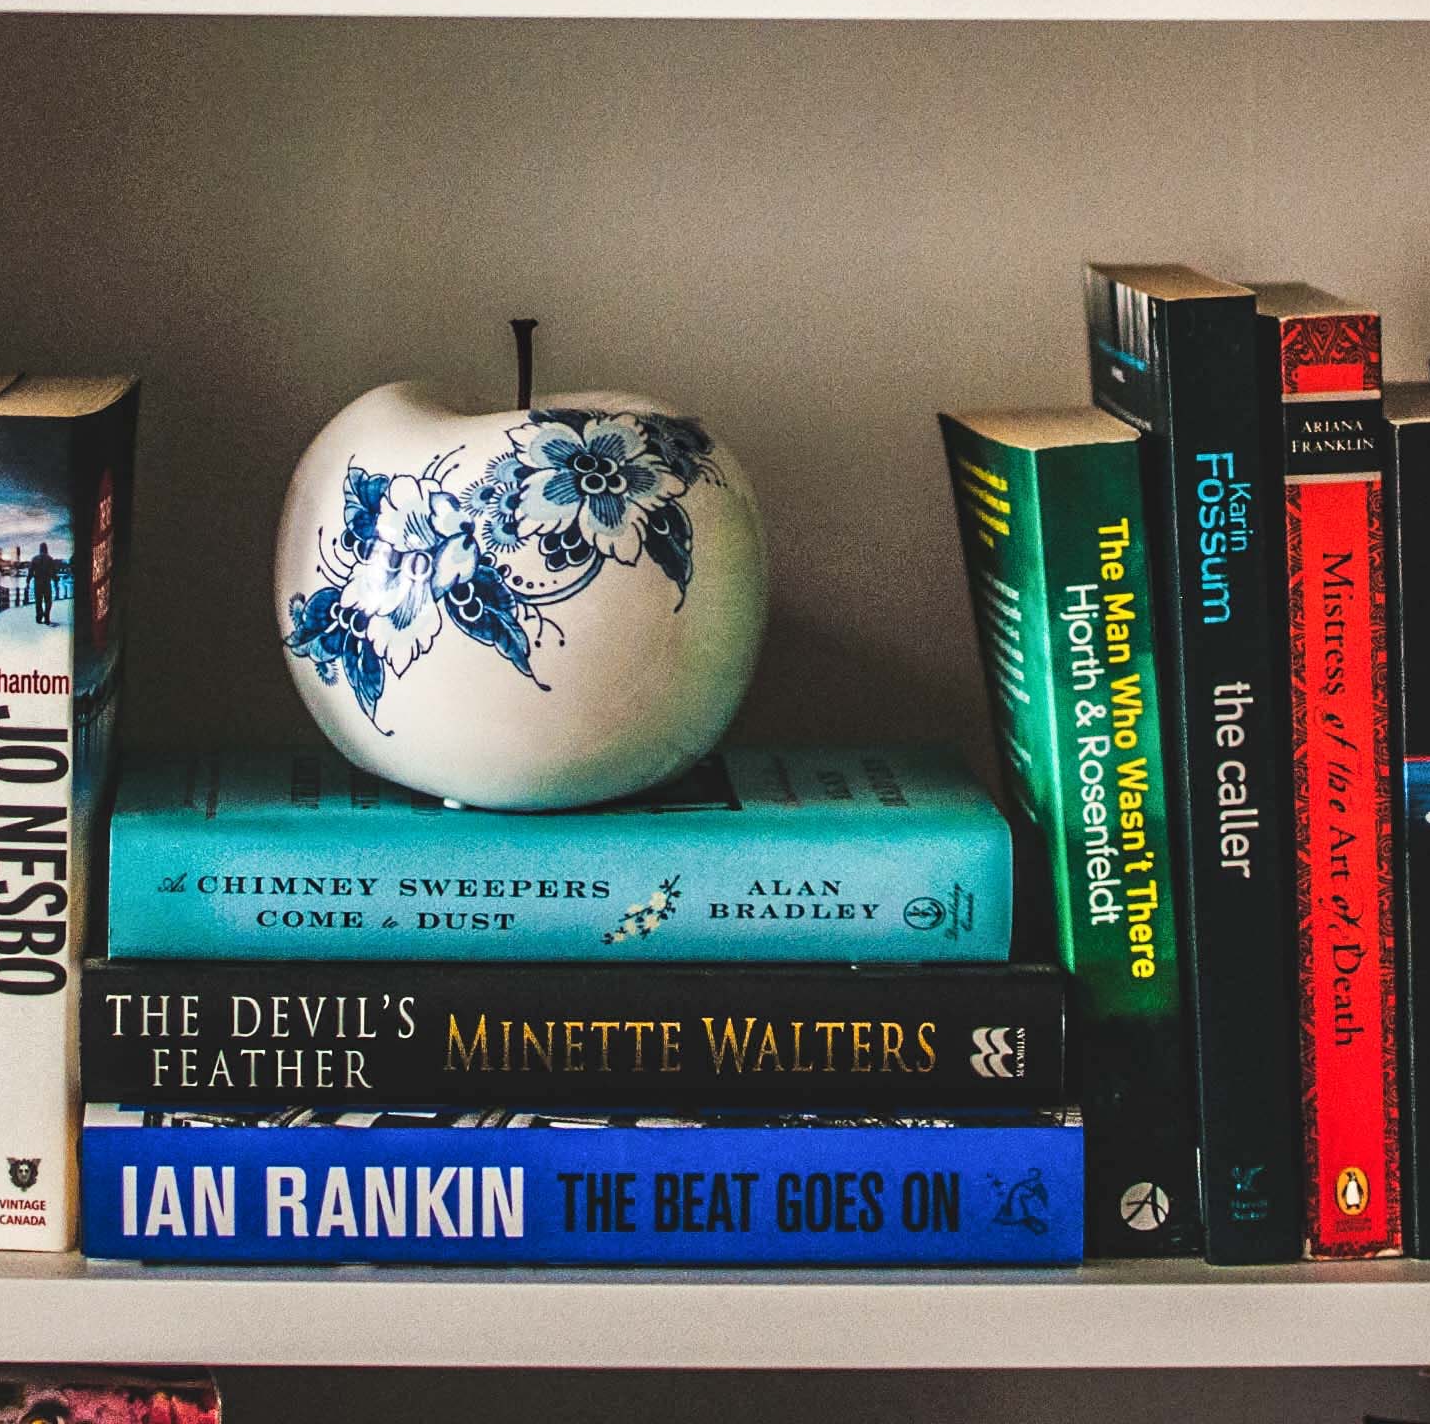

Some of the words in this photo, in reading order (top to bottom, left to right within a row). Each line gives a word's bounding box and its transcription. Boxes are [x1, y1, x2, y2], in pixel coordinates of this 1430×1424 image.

[1291, 438, 1375, 454] FRANKLIN
[1301, 420, 1364, 434] ARIANA
[1195, 451, 1235, 625] Fossum
[1228, 482, 1253, 552] Karin
[1213, 681, 1255, 748] the
[1217, 760, 1259, 879] caller
[197, 875, 379, 896] CHIMNEY
[398, 878, 611, 900] SWEEPERS
[256, 910, 364, 929] COME
[418, 912, 516, 931] DUST
[1017, 1027, 1026, 1078] MACMILLAN
[122, 1166, 235, 1238] IAN
[266, 1166, 525, 1239] RANKIN
[560, 1172, 637, 1233] THE
[653, 1172, 760, 1233] BEAT
[777, 1172, 884, 1233] GOES
[902, 1172, 960, 1233] ON
